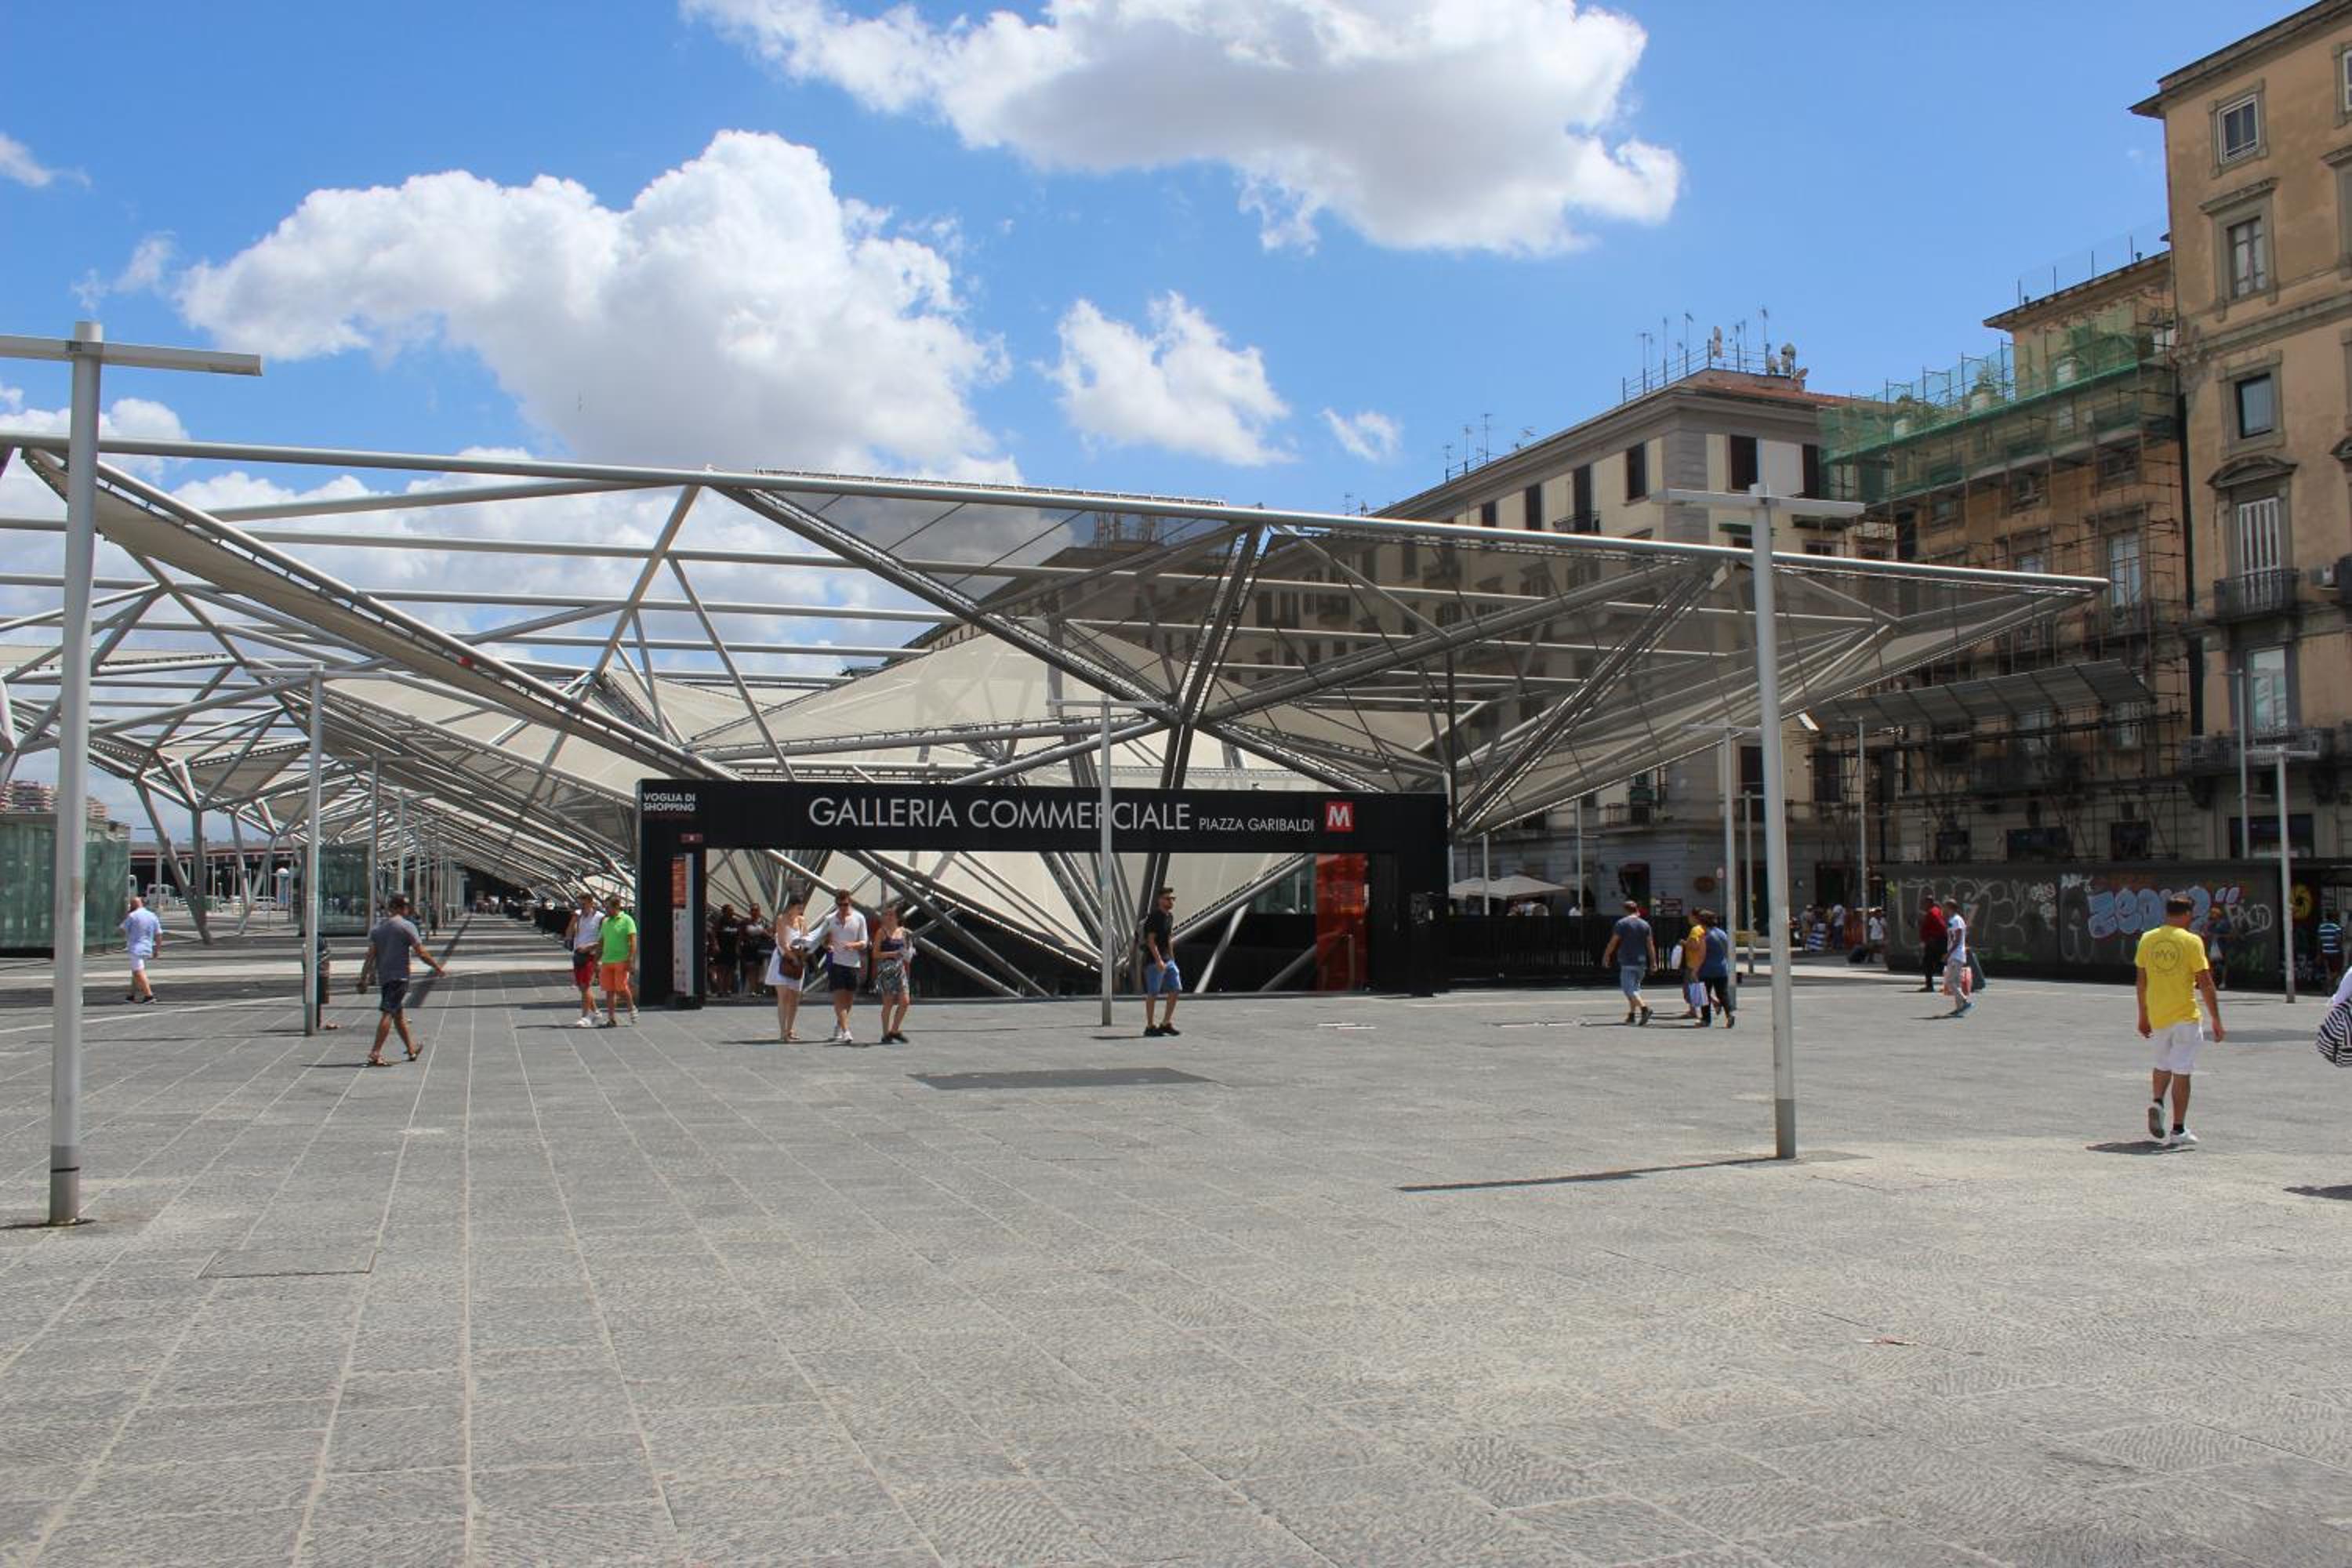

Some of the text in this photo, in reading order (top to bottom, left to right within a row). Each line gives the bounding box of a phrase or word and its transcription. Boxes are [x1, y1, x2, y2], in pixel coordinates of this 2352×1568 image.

[644, 793, 695, 802] VOGLIA DI
[644, 802, 695, 811] SHOPPING
[808, 797, 958, 828] GALLERIA
[1327, 805, 1351, 827] M
[1199, 818, 1315, 832] PIAZZA GARIBALDI
